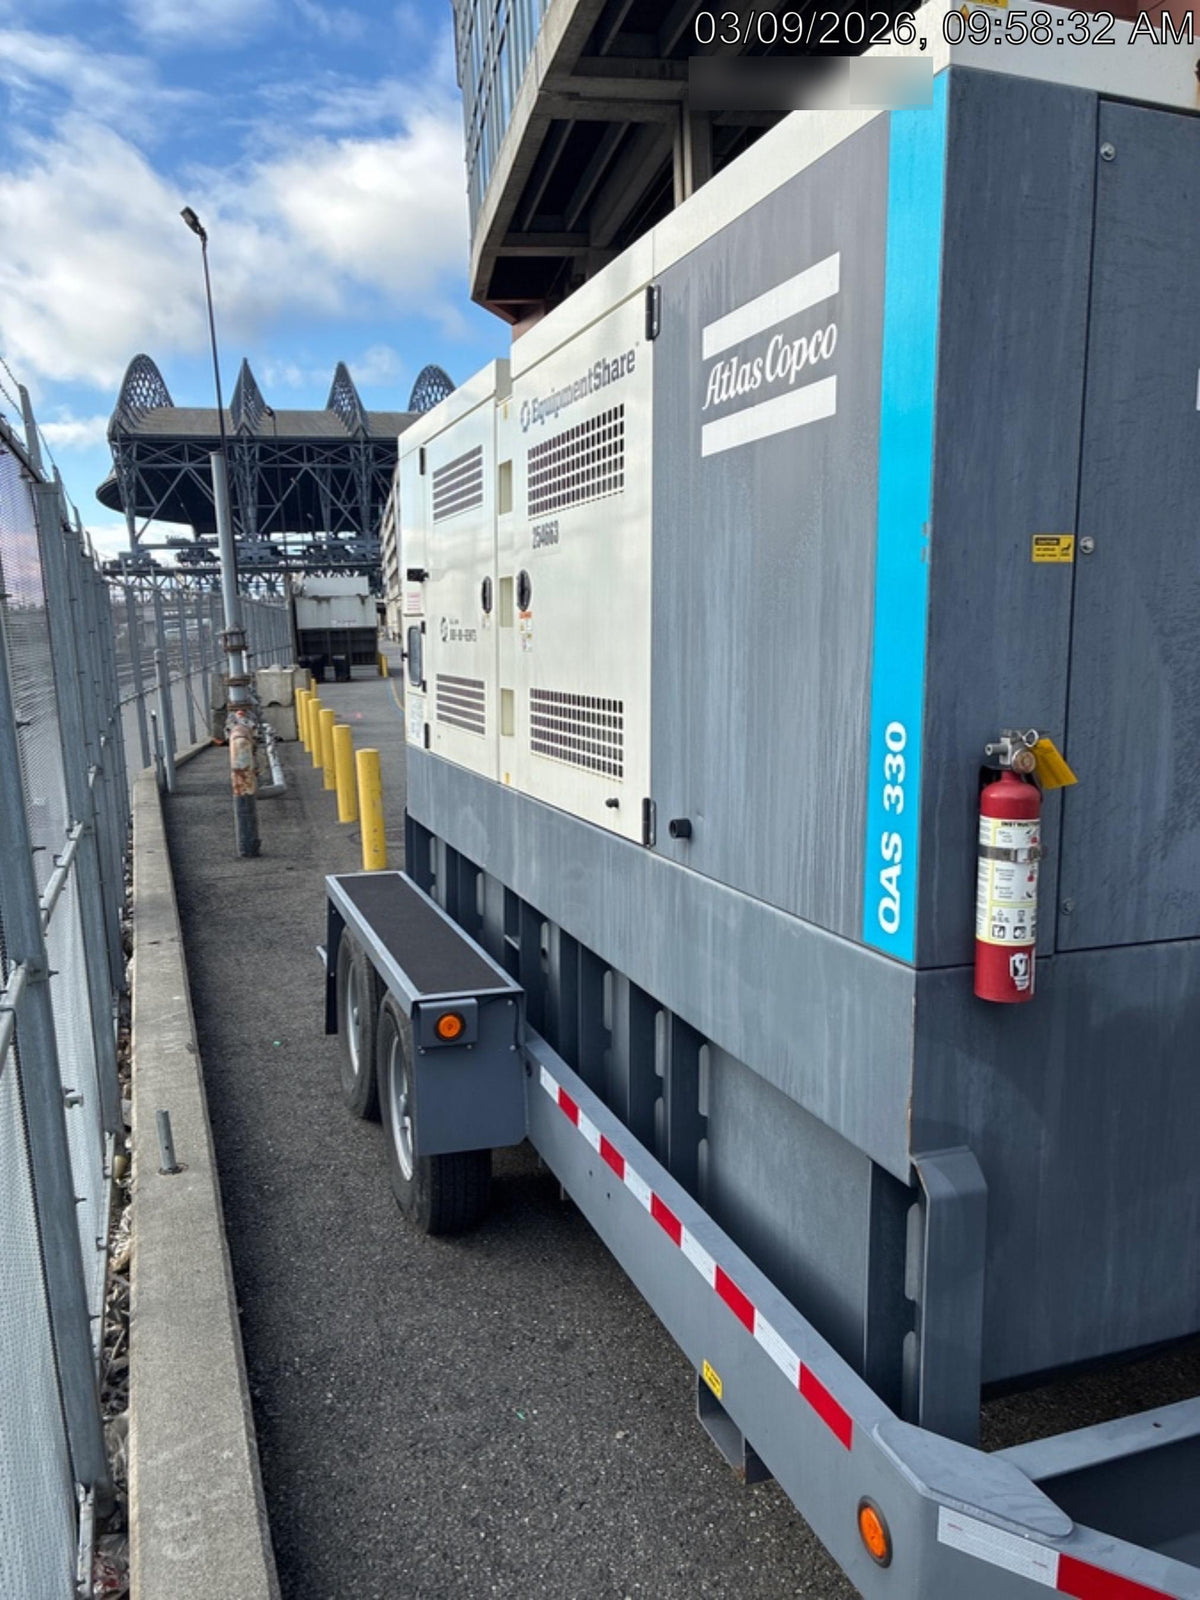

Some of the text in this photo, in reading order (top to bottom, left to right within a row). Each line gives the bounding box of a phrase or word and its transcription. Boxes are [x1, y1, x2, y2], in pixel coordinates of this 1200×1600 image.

[532, 349, 635, 425] EquipmentShare
[702, 323, 837, 410] Atlas Copco
[878, 721, 906, 934] QAS 330
